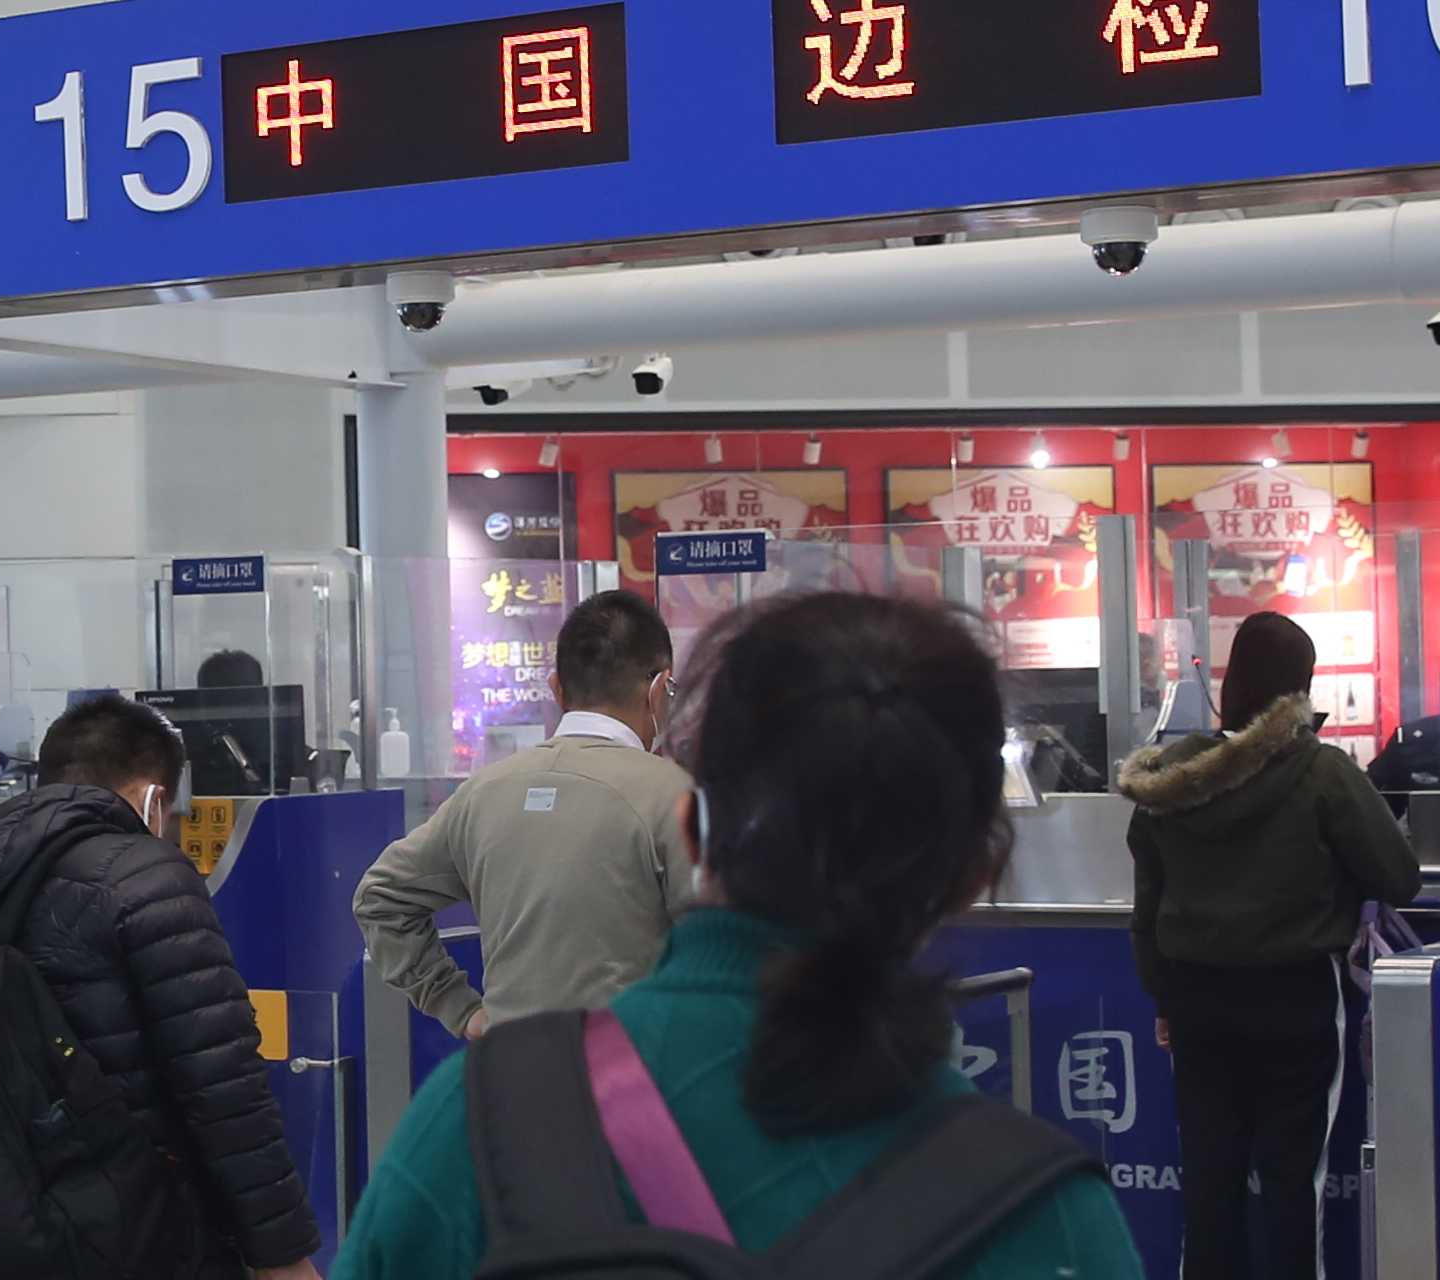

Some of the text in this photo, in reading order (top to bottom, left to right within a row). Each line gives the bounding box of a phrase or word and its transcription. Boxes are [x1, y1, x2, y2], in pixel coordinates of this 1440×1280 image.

[254, 25, 594, 168] 中国
[33, 57, 212, 222] 15
[700, 488, 763, 518] 爆品
[971, 484, 1033, 513] 爆品
[1232, 481, 1293, 509] 爆品
[956, 514, 1050, 543] 狂欢购
[1217, 510, 1311, 538] 狂欢购
[689, 538, 754, 559] 请摘口罩
